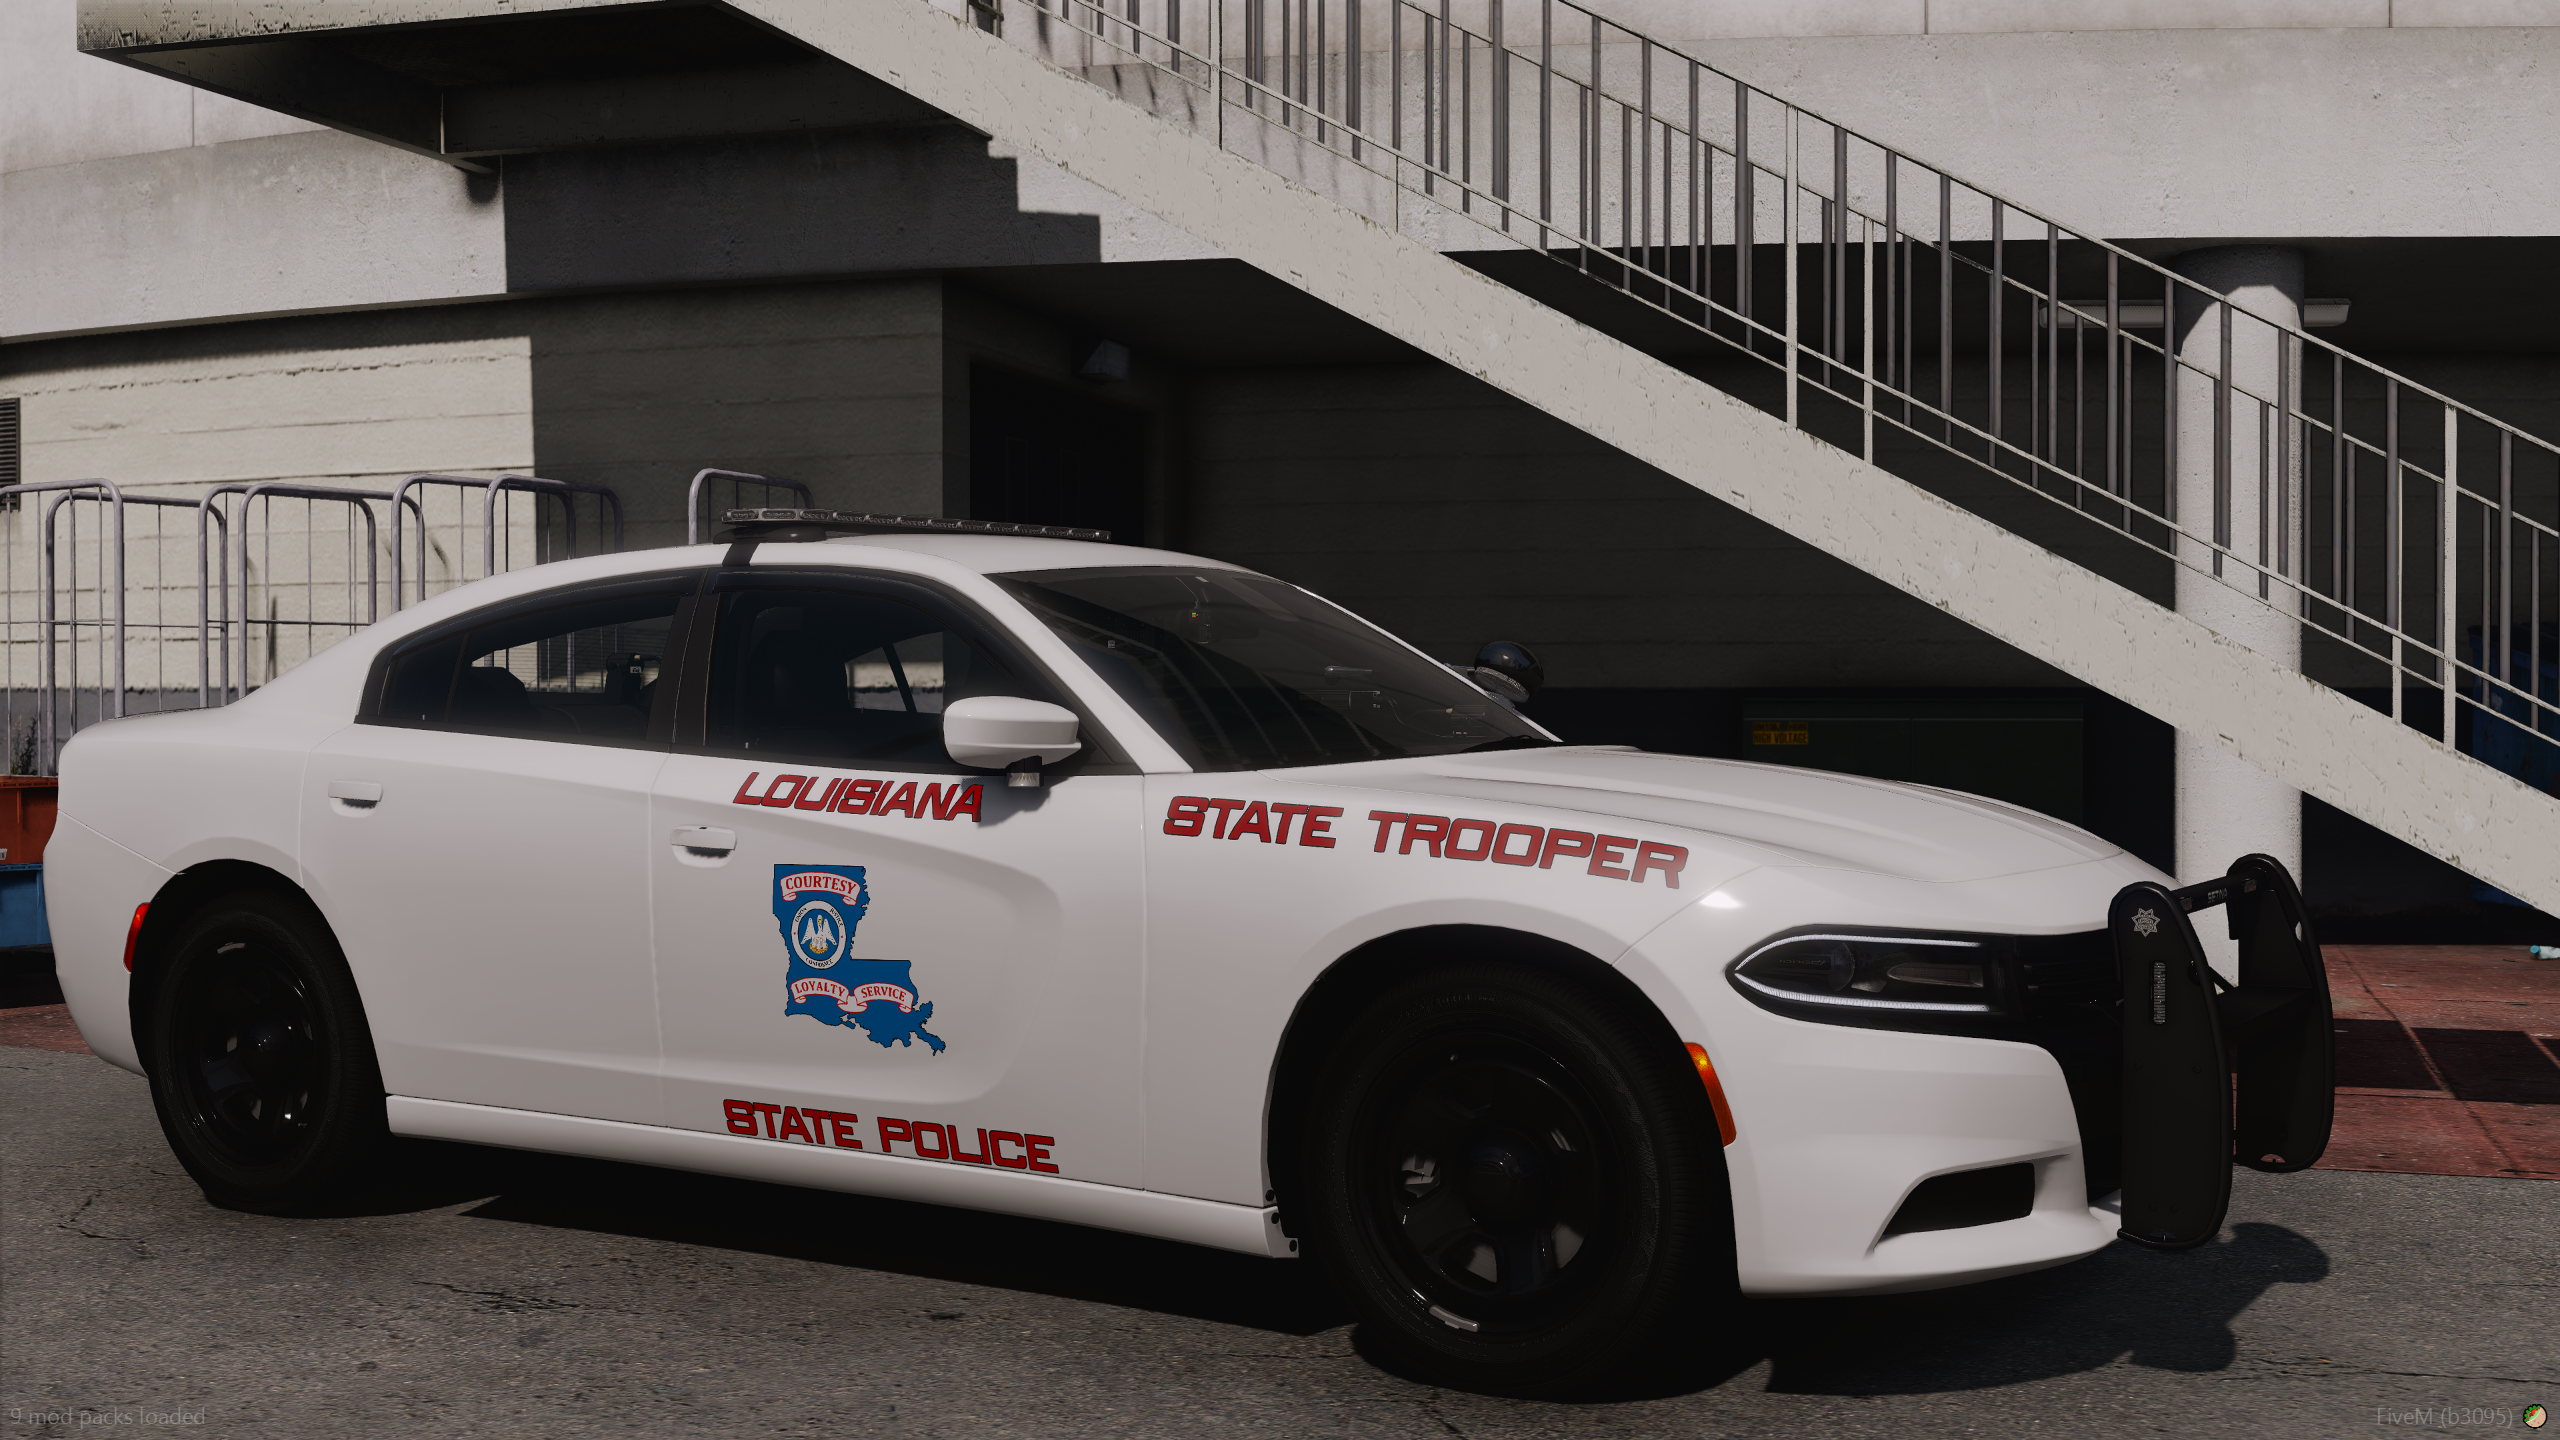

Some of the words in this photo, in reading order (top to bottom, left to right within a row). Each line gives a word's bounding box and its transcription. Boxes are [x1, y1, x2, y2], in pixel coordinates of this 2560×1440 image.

[1753, 732, 1772, 744] HIGH
[1774, 732, 1808, 744] VOLTAGE
[732, 771, 984, 823] LOUISIANA
[1162, 795, 1344, 849] STATE
[1367, 809, 1690, 890] TROOPER
[785, 875, 857, 895] COURTESY
[794, 980, 846, 997] LOYALTY
[860, 985, 907, 1002] SERVICE
[722, 1098, 863, 1150] STATE
[877, 1115, 1060, 1175] POLICE
